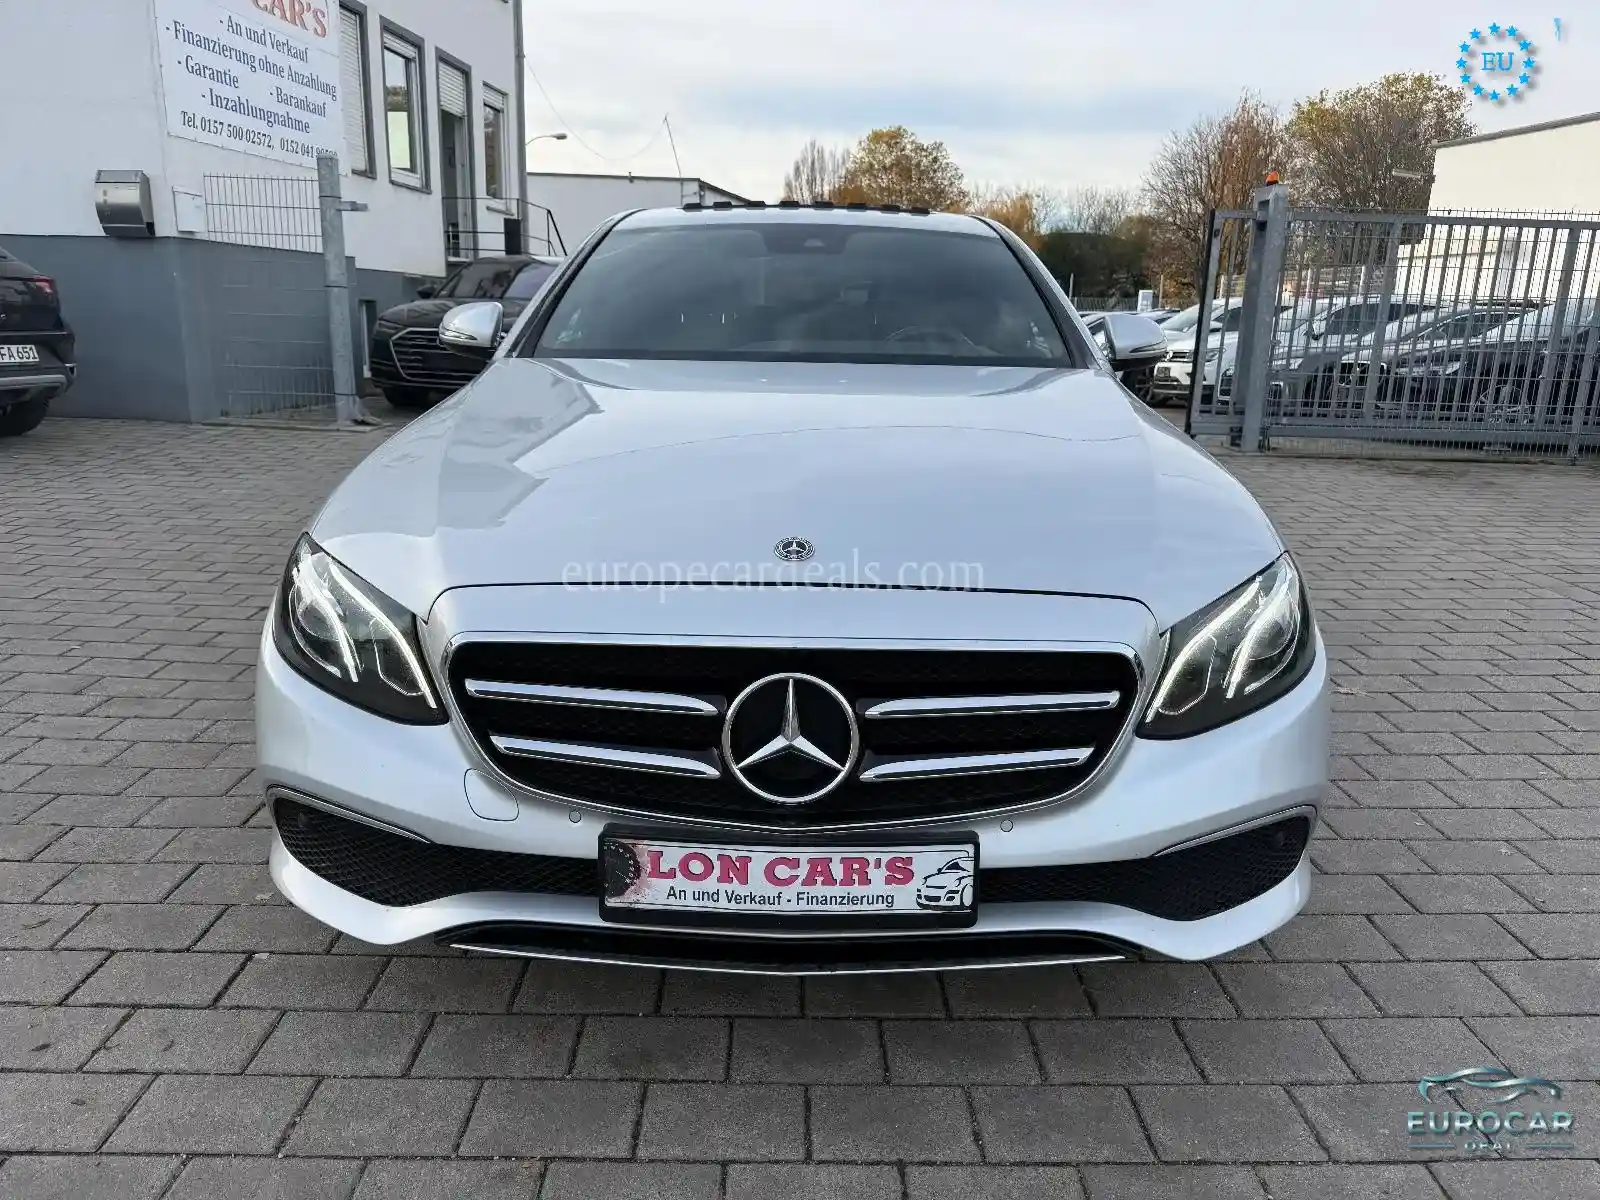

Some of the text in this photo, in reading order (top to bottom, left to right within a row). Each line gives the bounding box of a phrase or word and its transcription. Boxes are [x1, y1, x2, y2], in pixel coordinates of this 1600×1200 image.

[226, 15, 309, 64] An und Verkauf
[173, 20, 337, 102] Finanzierung ohne Anzahlung
[185, 55, 239, 88] Garantie
[209, 88, 310, 134] Inzahlungnahme
[275, 86, 327, 118] Barankauf
[181, 111, 198, 130] Tel.
[200, 119, 224, 137] 0157
[226, 124, 243, 141] 500
[280, 137, 299, 155] 0152
[300, 143, 314, 158] 041
[17, 346, 38, 360] 651
[647, 849, 752, 886] LON
[763, 856, 914, 887] CAR'S
[666, 885, 688, 902] An
[692, 887, 721, 904] und
[724, 889, 783, 906] Verkauf
[796, 891, 895, 909] Finanzierung
